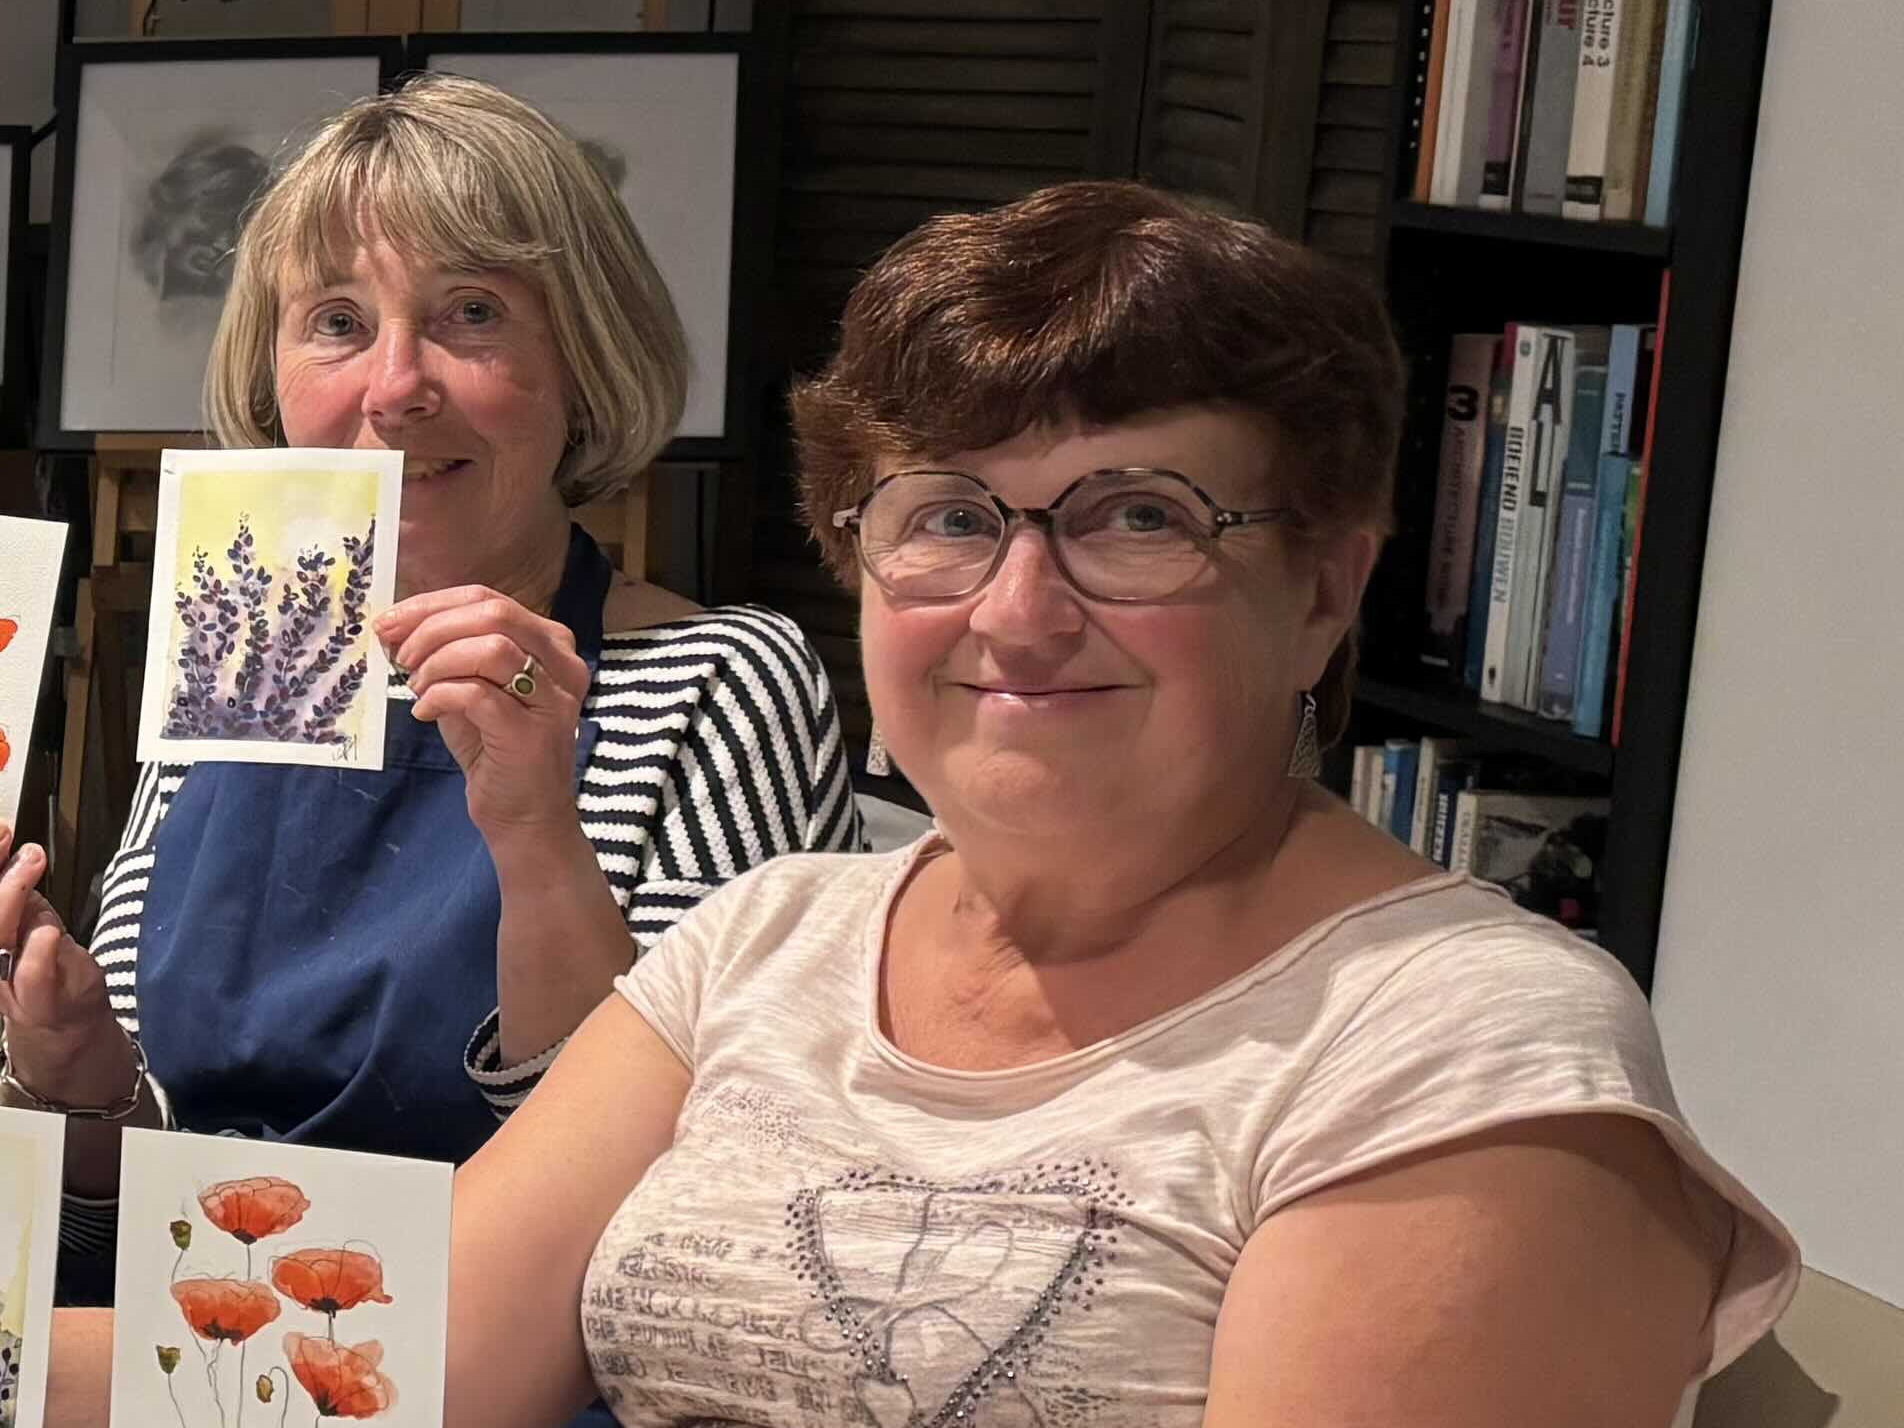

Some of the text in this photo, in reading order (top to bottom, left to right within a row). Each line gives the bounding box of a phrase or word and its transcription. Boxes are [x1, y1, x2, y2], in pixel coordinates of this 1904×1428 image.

[1595, 47, 1611, 68] 3
[1447, 384, 1480, 422] 3
[1492, 515, 1514, 604] BOUWEN
